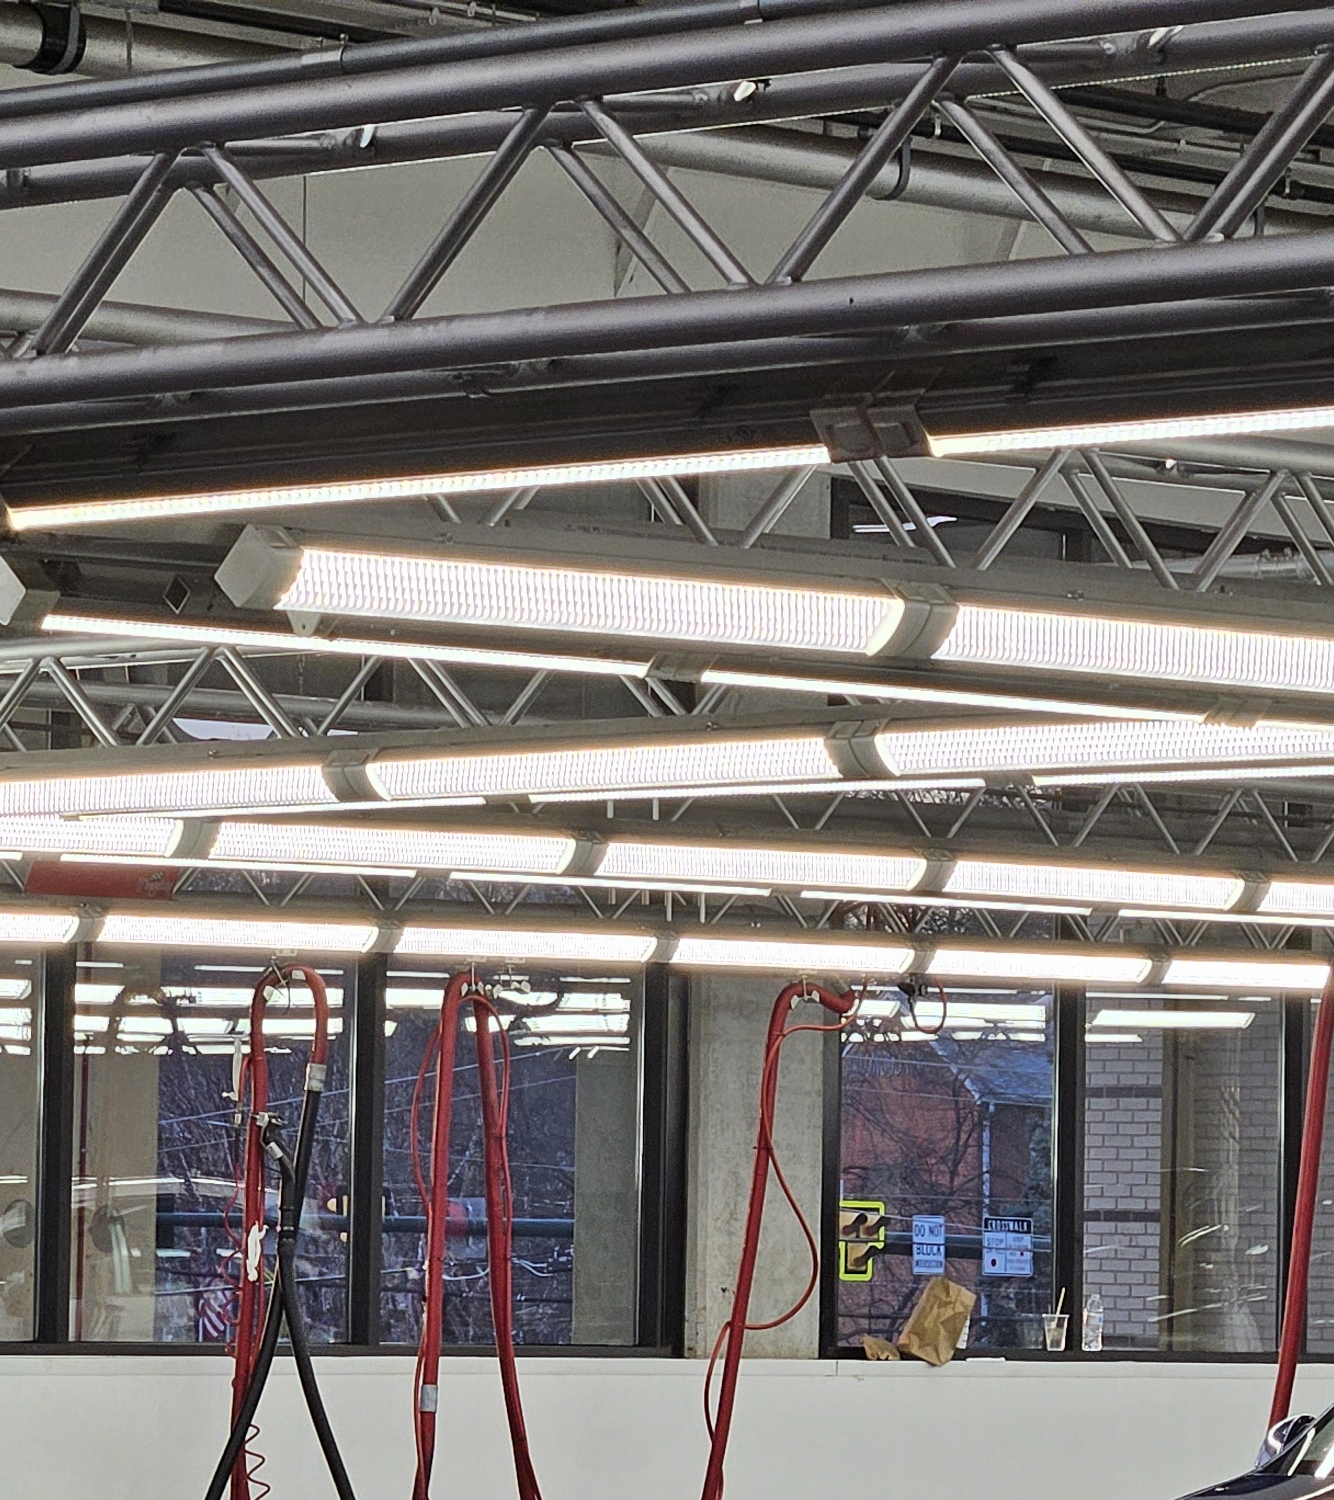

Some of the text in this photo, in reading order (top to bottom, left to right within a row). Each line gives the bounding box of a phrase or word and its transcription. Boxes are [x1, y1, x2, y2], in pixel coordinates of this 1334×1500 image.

[915, 1224, 942, 1237] DO NOT
[986, 1238, 1004, 1247] STOP
